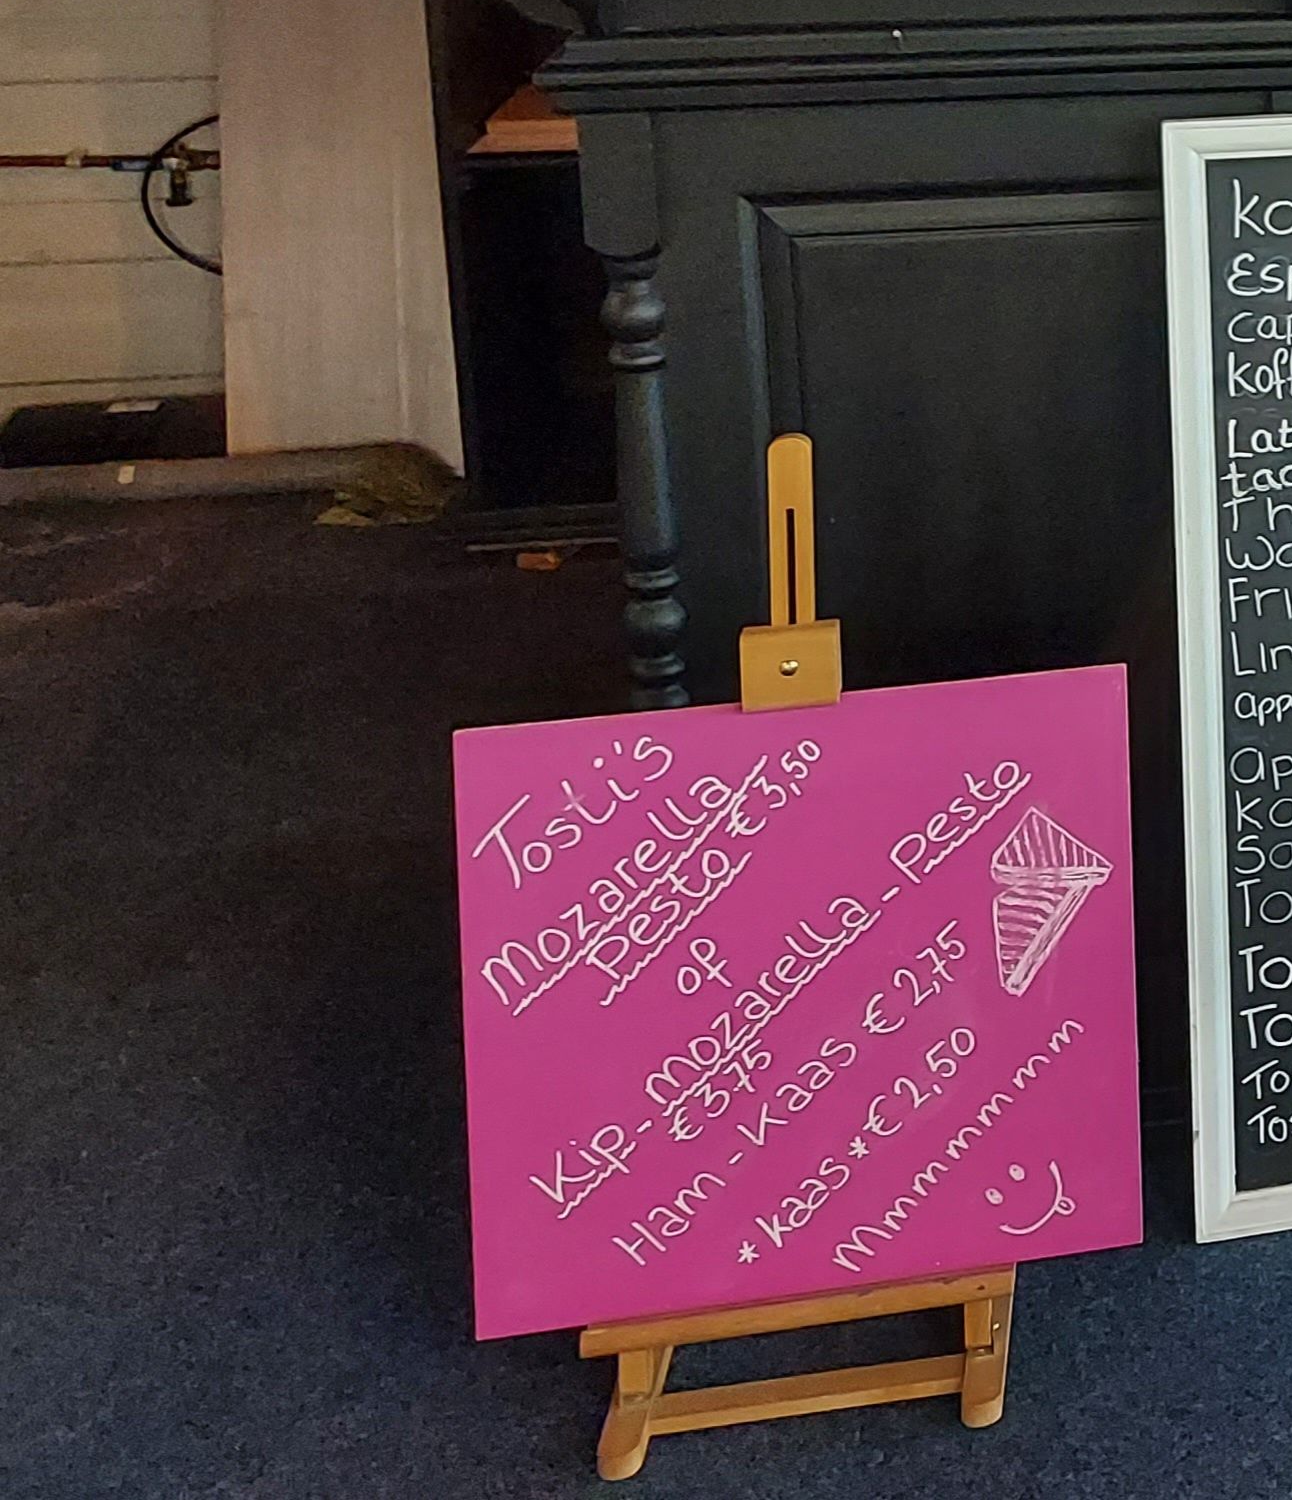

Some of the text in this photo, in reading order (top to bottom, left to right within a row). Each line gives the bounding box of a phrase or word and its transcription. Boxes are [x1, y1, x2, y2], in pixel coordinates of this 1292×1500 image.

[472, 736, 673, 889] Tosti's
[677, 938, 732, 994] of
[613, 1171, 726, 1266] Ham
